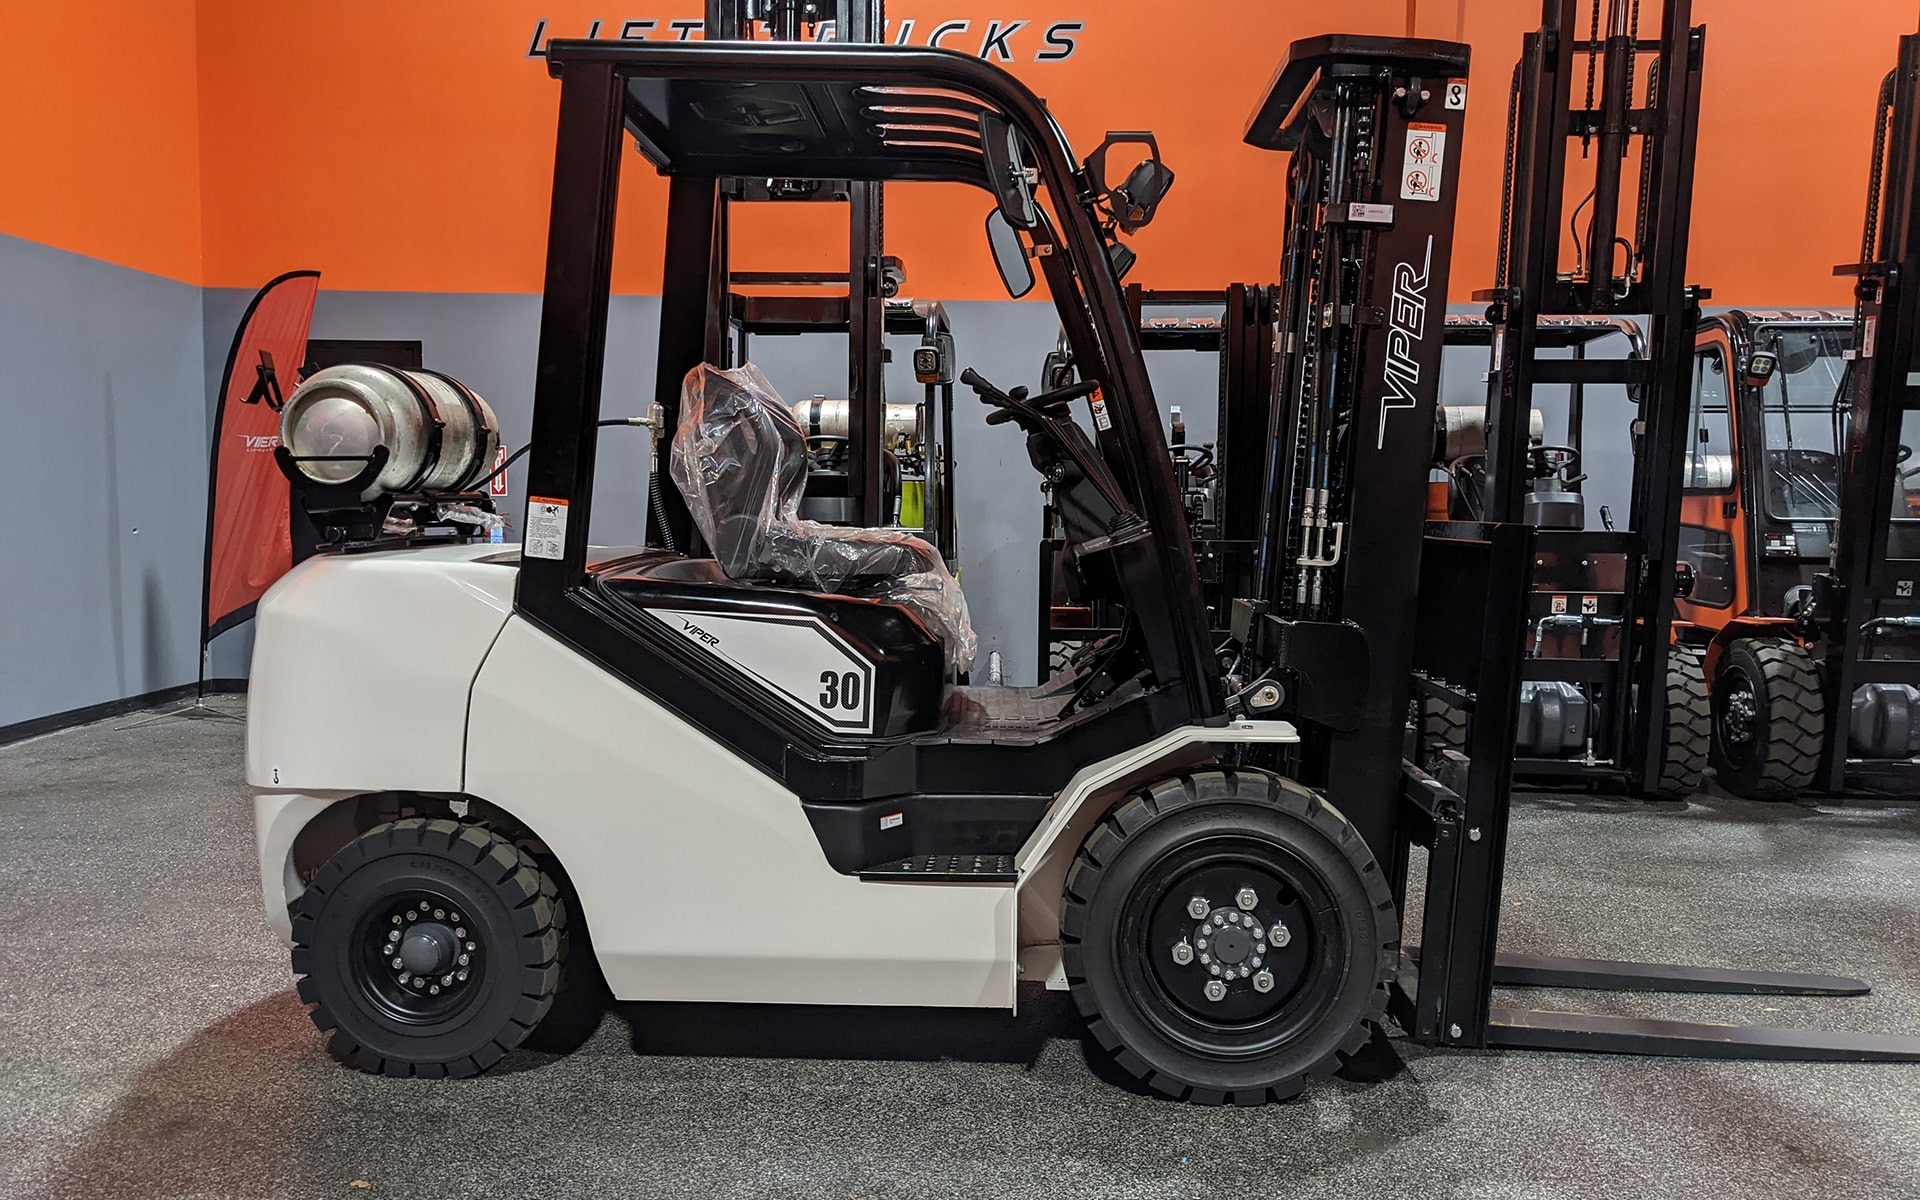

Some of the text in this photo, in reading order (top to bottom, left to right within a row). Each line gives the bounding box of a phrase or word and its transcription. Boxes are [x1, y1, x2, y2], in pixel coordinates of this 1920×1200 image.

[1378, 235, 1433, 449] VIPER
[677, 615, 722, 651] VIPER
[820, 671, 860, 710] 30
